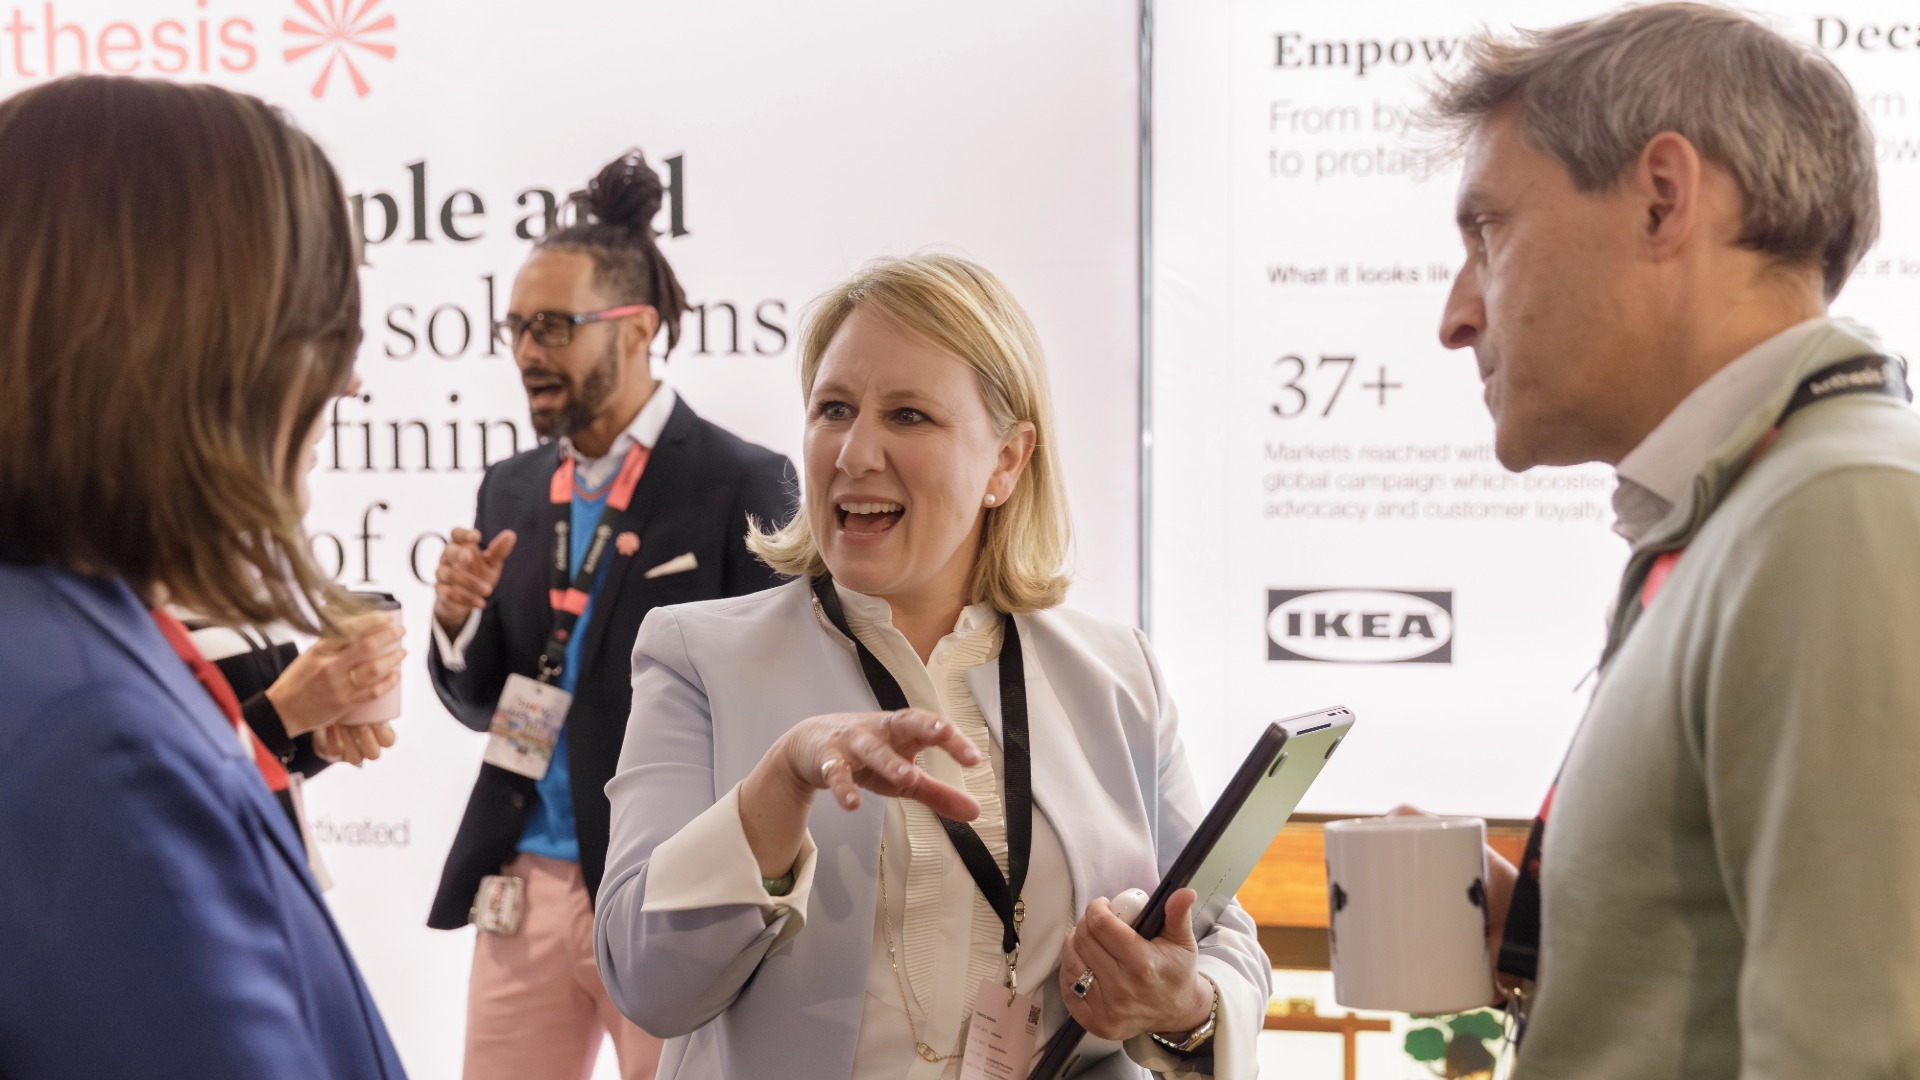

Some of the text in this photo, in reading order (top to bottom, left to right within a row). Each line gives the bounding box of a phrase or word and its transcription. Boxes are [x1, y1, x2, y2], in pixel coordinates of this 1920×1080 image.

[0, 0, 257, 77] thesis
[1814, 16, 1920, 50] Dec
[1272, 32, 1460, 76] Empow
[1269, 98, 1409, 138] From by
[1269, 147, 1303, 178] to
[1267, 263, 1457, 285] What it looks lik
[1269, 354, 1403, 419] 37+
[327, 393, 520, 471] finin
[1264, 442, 1351, 462] Markets
[1359, 442, 1450, 462] reached
[1263, 471, 1330, 495] global
[1335, 471, 1446, 495] campaign
[1453, 471, 1516, 491] which
[1263, 500, 1605, 523] advocacy and customer loyalty
[1287, 612, 1435, 639] IKEA
[308, 815, 411, 848] tivated
